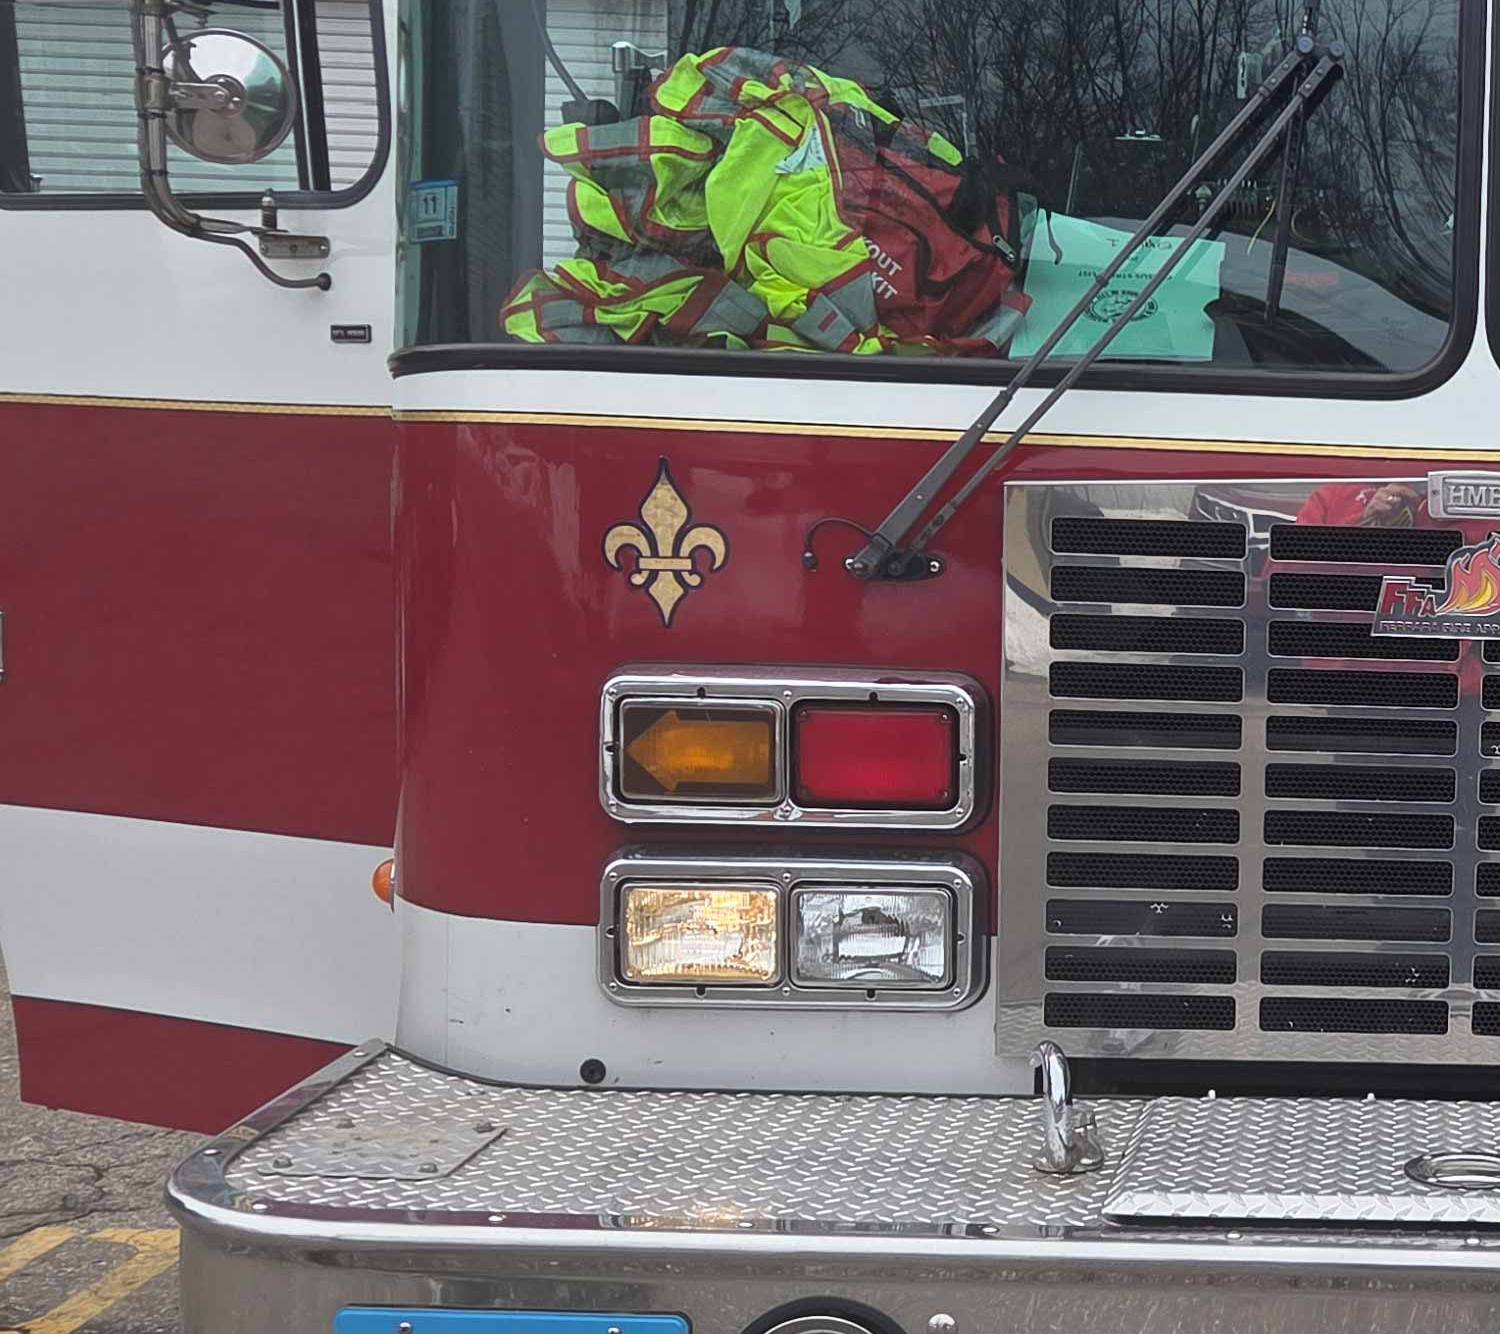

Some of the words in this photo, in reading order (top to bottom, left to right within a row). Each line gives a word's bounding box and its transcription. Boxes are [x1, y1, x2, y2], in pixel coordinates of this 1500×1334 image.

[872, 271, 898, 299] KIT
[1380, 580, 1437, 617] FFA
[1380, 620, 1439, 633] FERRARA
[1443, 622, 1472, 634] FIRE
